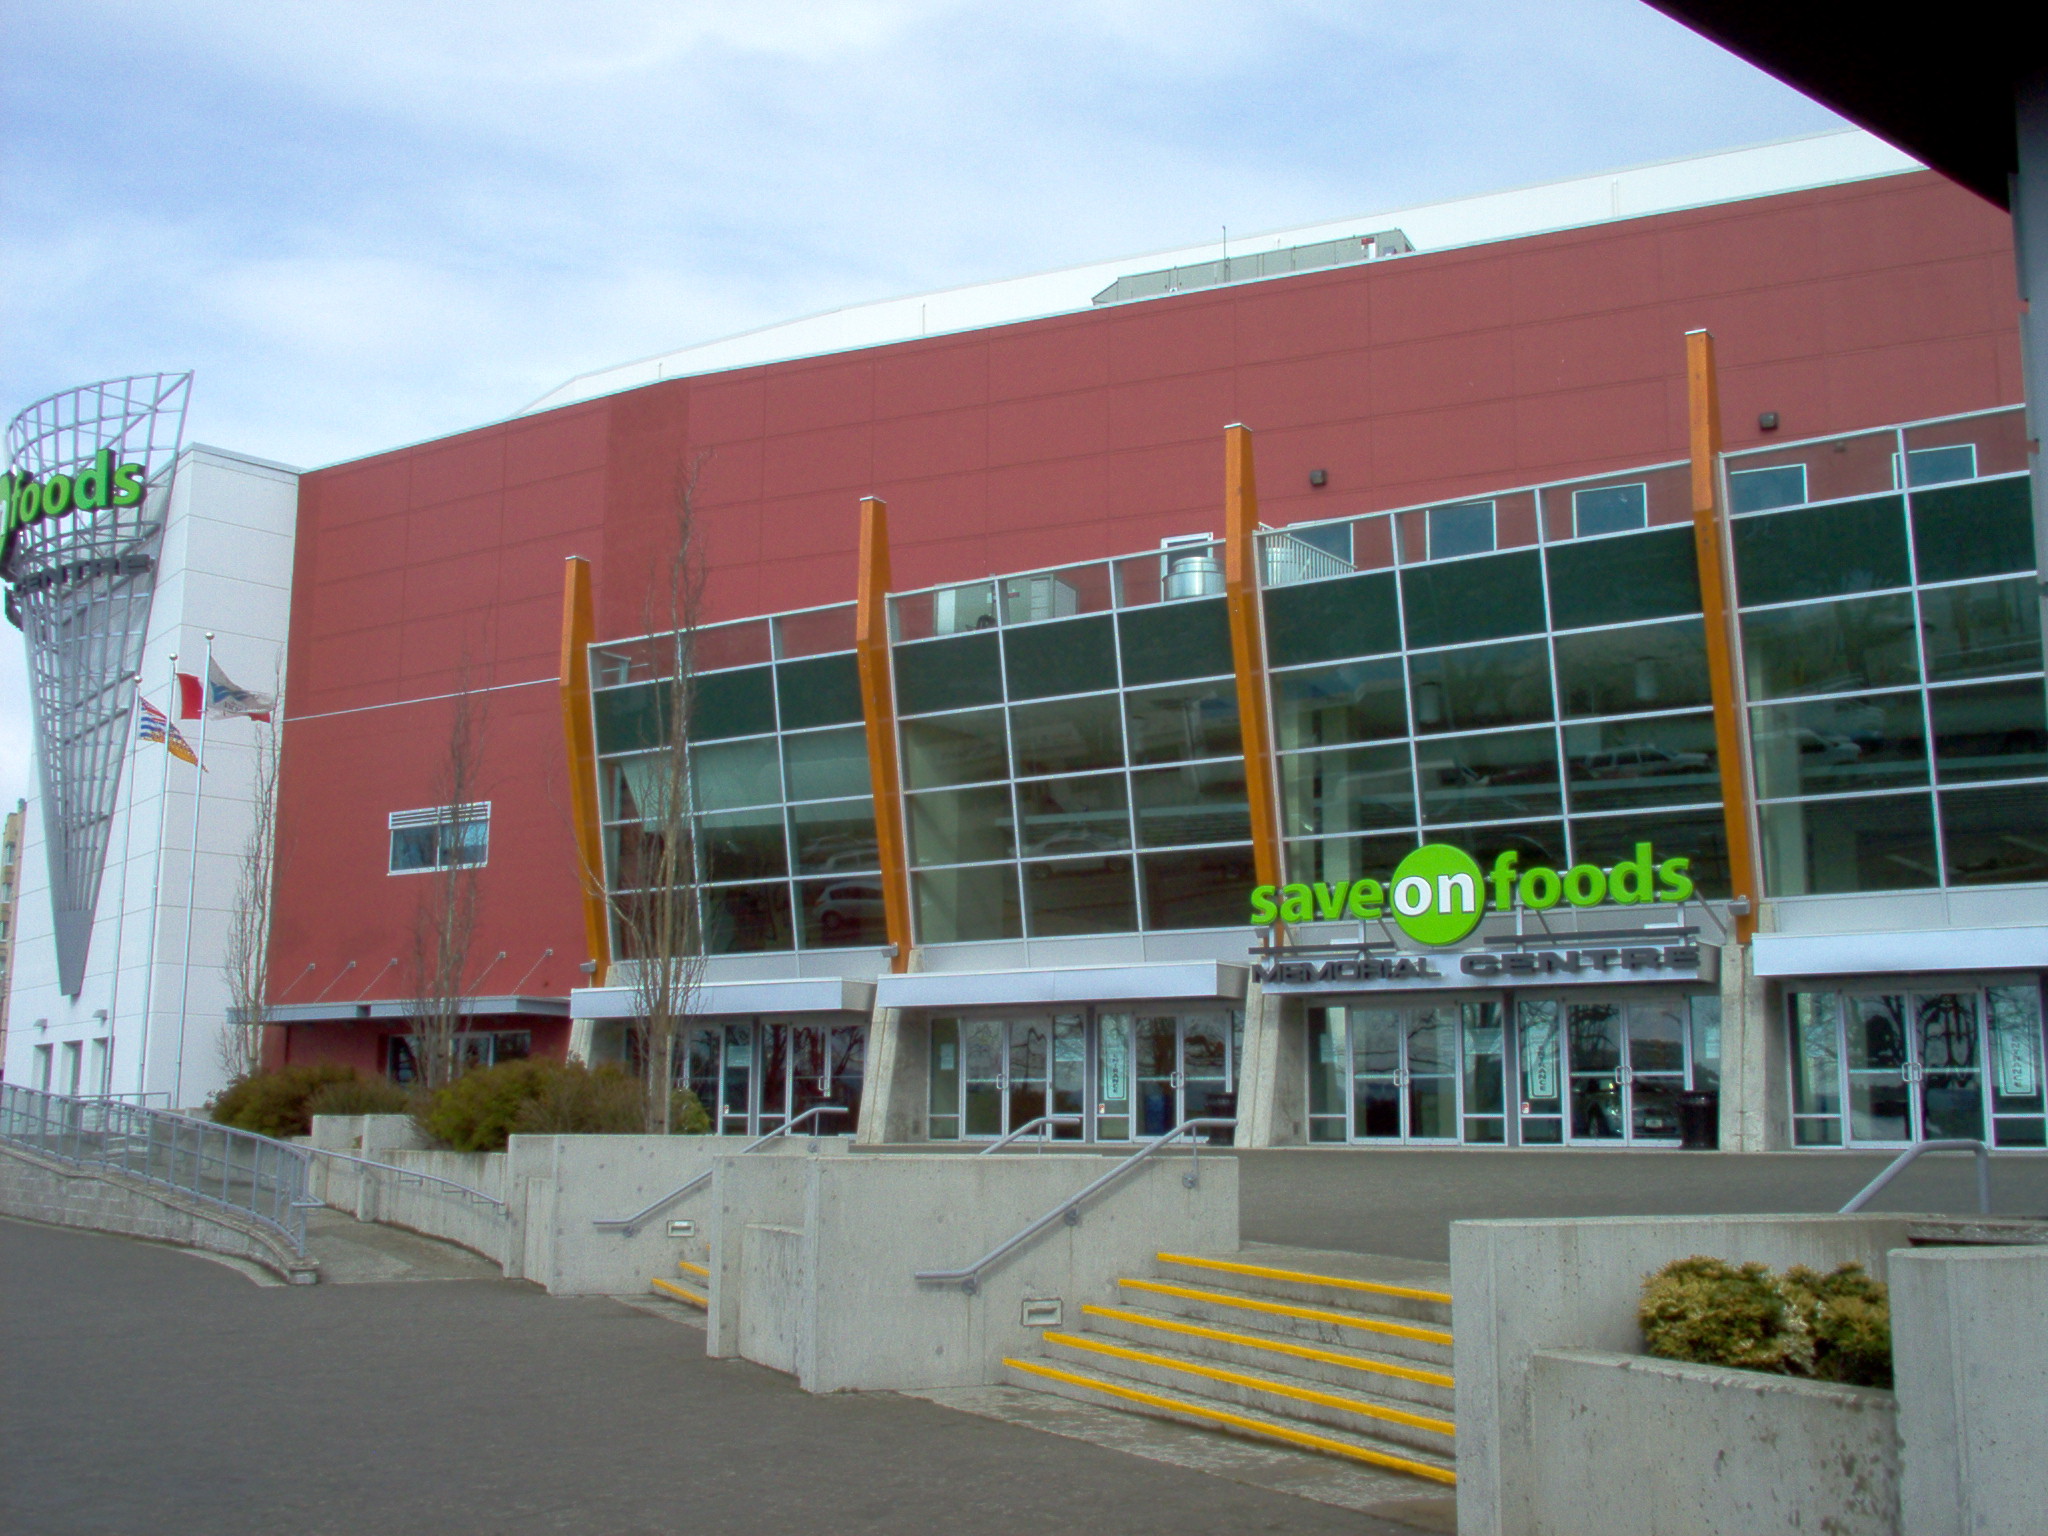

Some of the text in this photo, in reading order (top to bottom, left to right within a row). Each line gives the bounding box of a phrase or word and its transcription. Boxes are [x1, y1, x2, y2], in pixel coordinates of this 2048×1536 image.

[10, 448, 147, 530] foods
[1250, 842, 1694, 925] save on foods
[1251, 946, 1701, 984] MEMORIAL CENTRE
